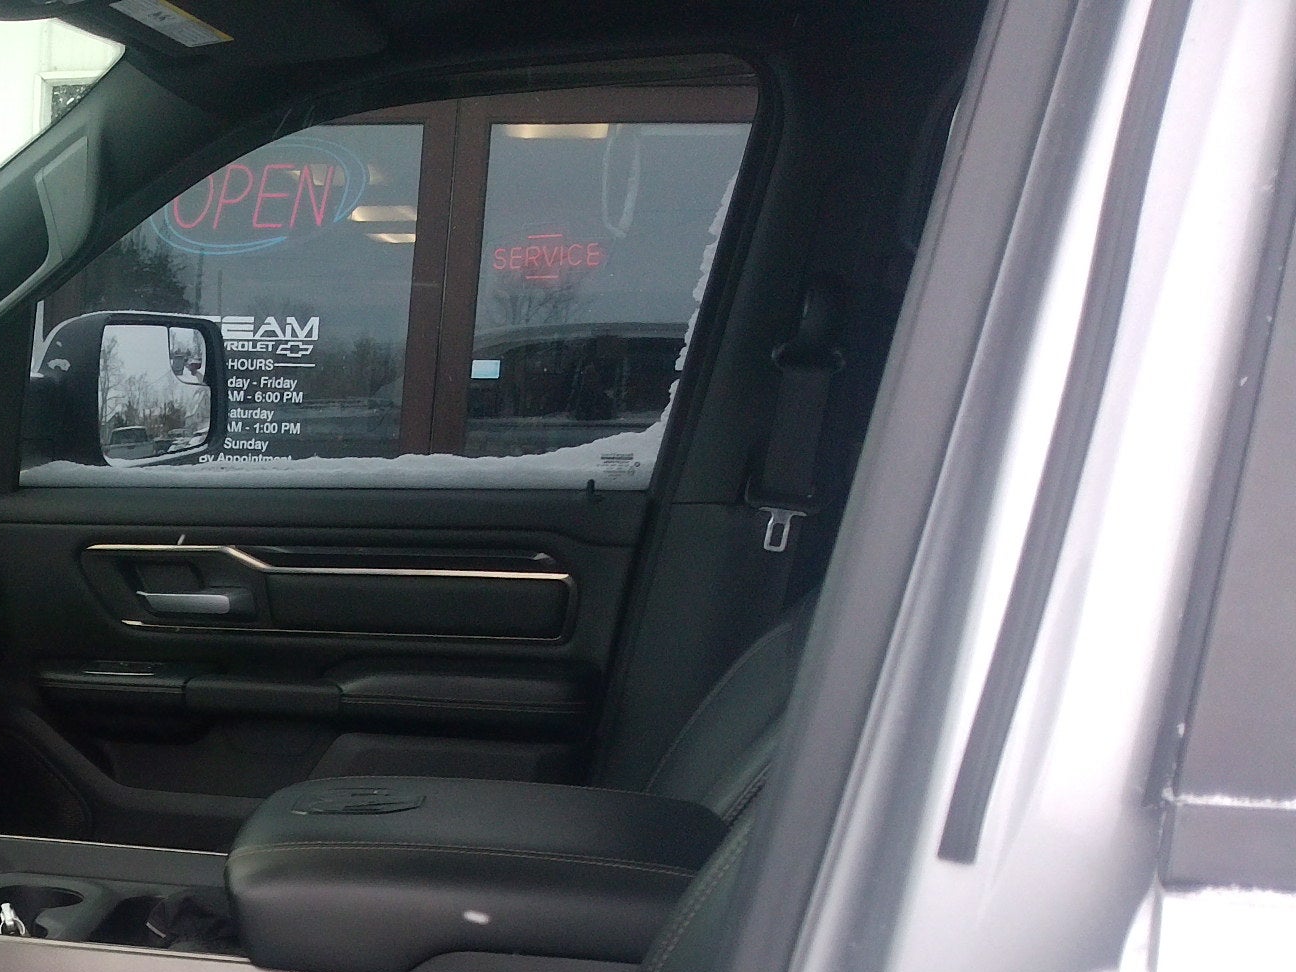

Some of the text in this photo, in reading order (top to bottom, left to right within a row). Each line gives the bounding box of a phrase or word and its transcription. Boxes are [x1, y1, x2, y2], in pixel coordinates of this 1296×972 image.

[173, 163, 336, 229] OPEN
[492, 243, 601, 270] SERVICE
[202, 315, 320, 341] EAM
[224, 341, 276, 352] ROLET
[227, 358, 274, 371] HOURS
[227, 376, 250, 390] day
[260, 376, 298, 391] Friday
[254, 391, 280, 403] 6:00
[283, 391, 304, 403] PM
[227, 407, 275, 421] aturday
[253, 422, 278, 434] 1:00
[281, 422, 301, 435] PM
[223, 437, 269, 452] Sunday
